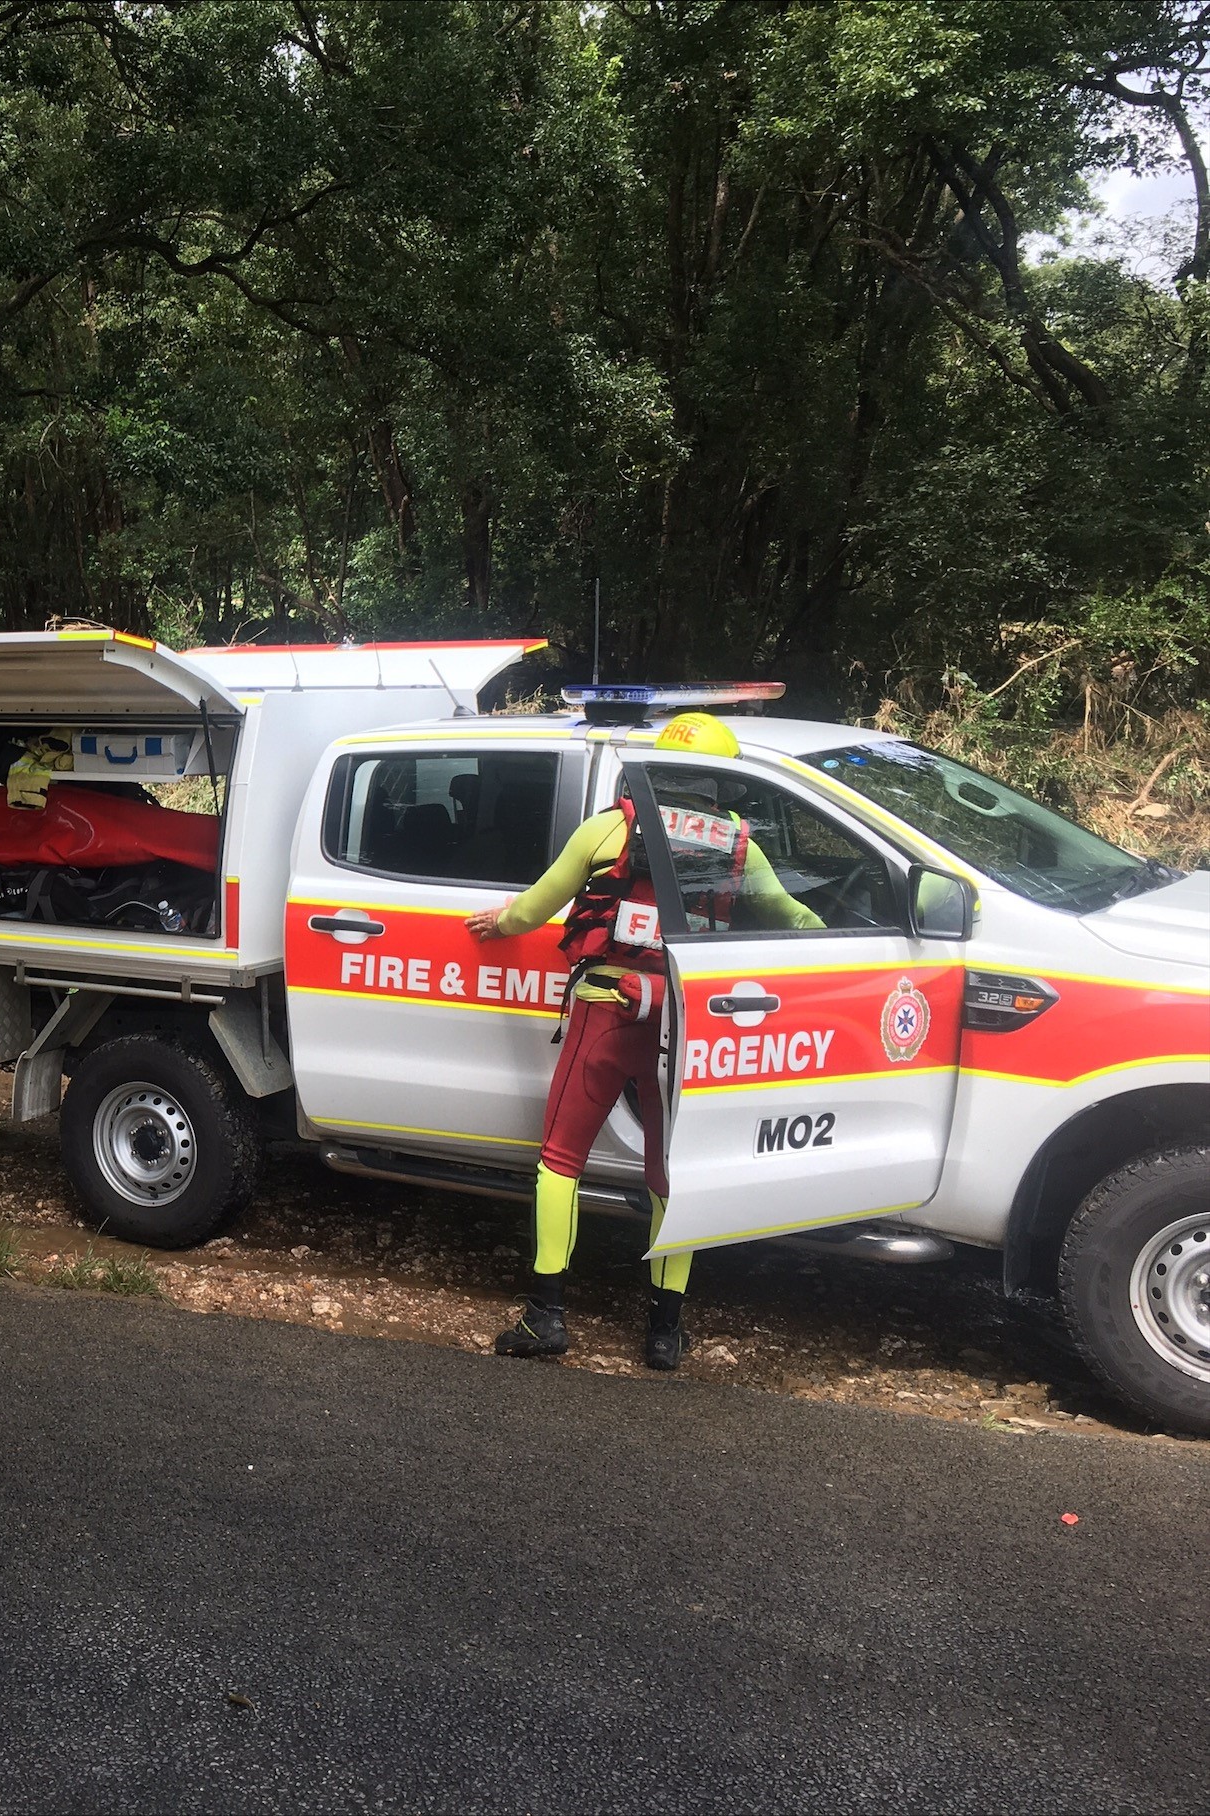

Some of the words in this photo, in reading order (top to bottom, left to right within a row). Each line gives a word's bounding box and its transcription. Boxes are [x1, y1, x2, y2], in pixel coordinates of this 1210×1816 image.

[660, 723, 698, 745] FIRE
[341, 952, 431, 992] FIRE
[440, 962, 466, 997] &
[684, 1029, 835, 1081] RGENCY
